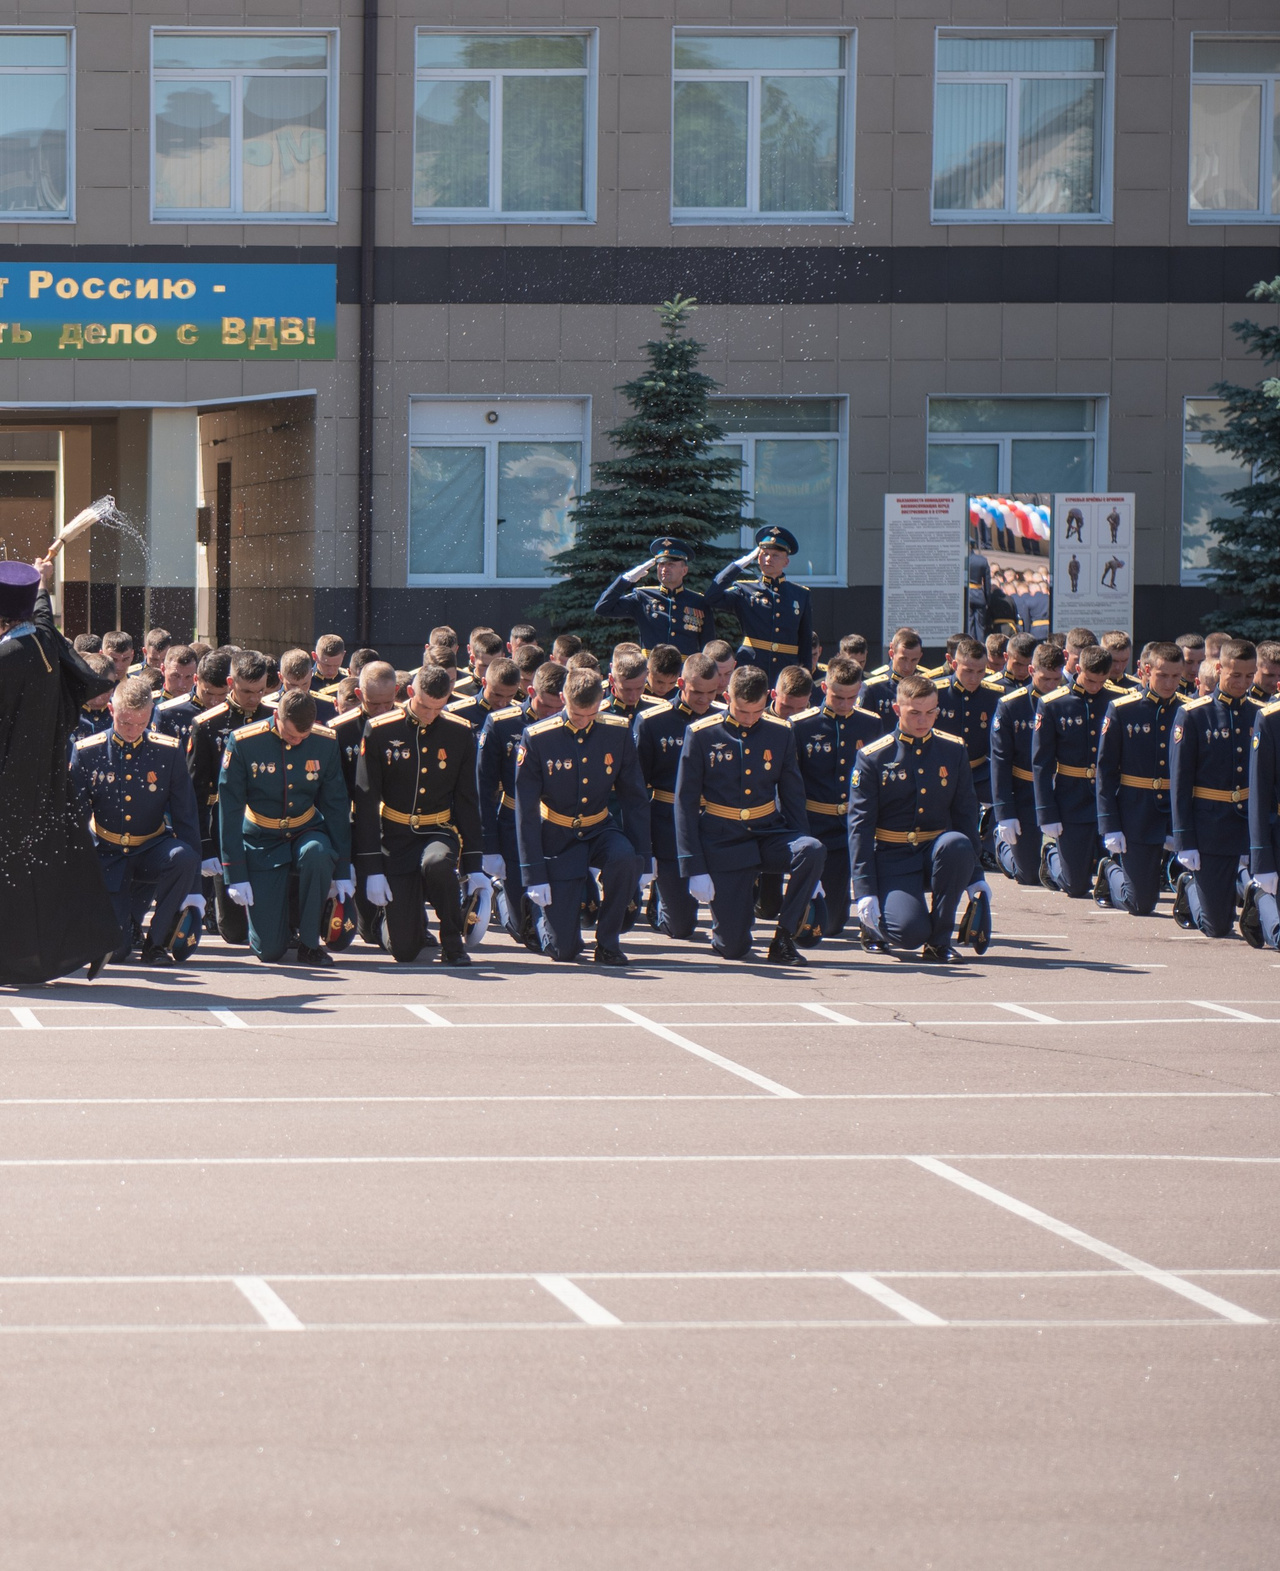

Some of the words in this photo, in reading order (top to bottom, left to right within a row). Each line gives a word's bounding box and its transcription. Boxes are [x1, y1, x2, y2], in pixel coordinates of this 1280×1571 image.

[29, 270, 197, 300] Россию
[58, 322, 158, 350] дело
[176, 323, 200, 345] с
[221, 316, 317, 350] ВДВ!
